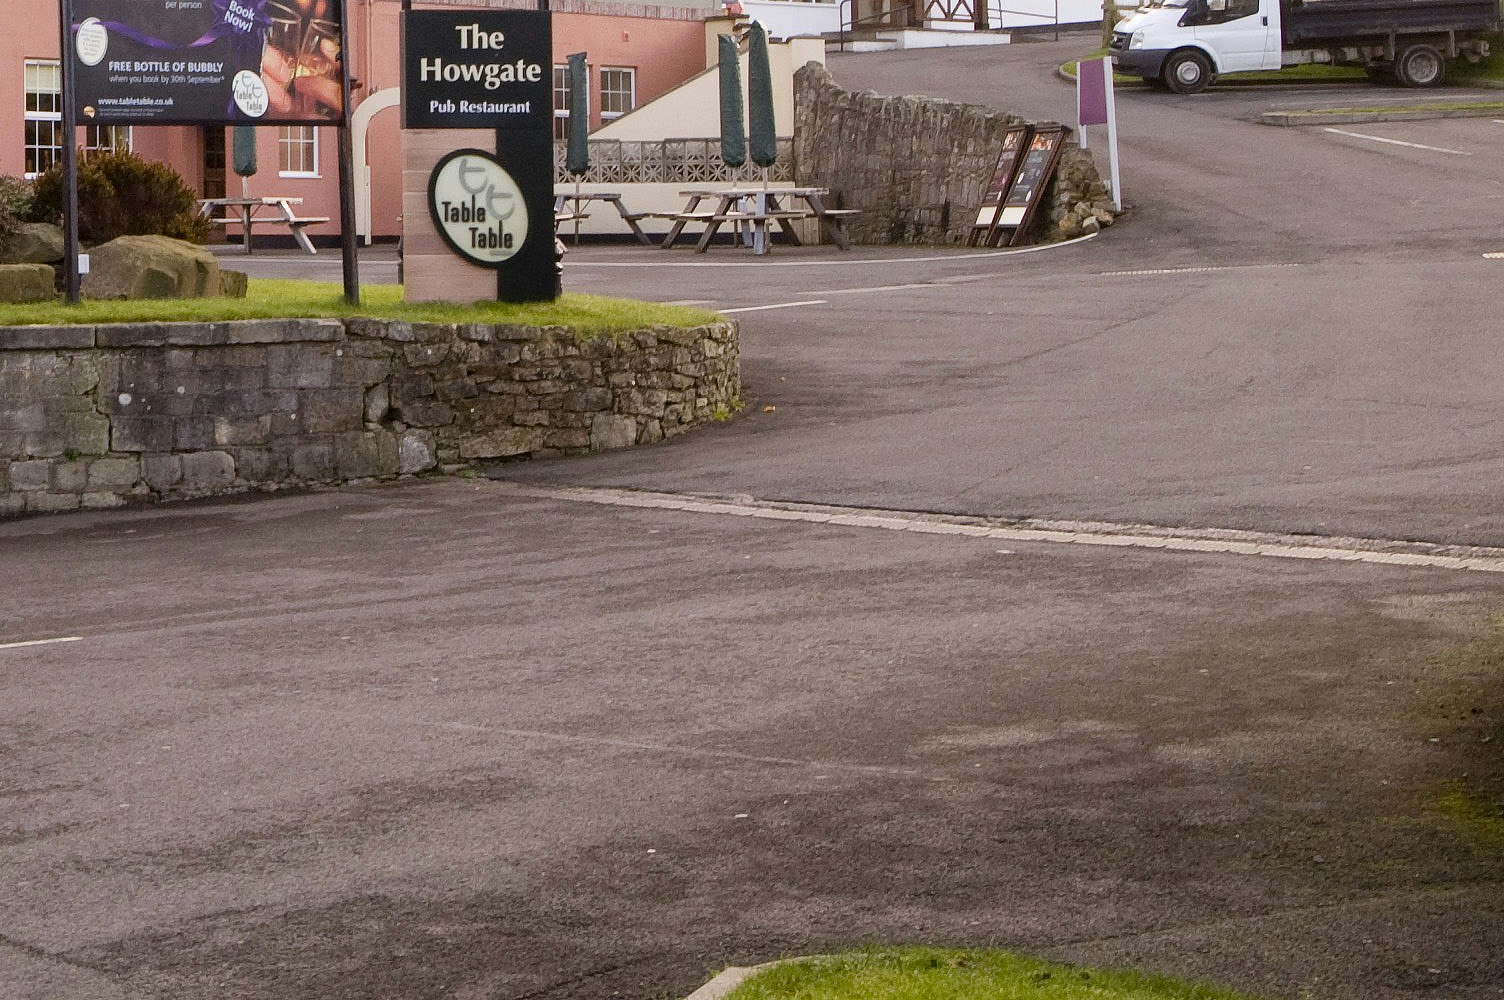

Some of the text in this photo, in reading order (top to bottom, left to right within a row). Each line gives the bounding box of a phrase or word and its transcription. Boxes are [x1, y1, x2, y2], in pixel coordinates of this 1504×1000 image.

[229, 0, 255, 21] Book
[224, 11, 253, 33] Now!
[455, 23, 505, 50] The
[109, 61, 224, 73] FREE BOTTLE OF BUBBLY
[420, 57, 541, 90] Howgate
[109, 75, 128, 83] when
[160, 75, 169, 85] by
[236, 87, 252, 100] Table
[246, 98, 263, 111] Table
[429, 100, 530, 114] Pub Restaurant
[442, 194, 486, 223] Table
[468, 220, 513, 249] Table
